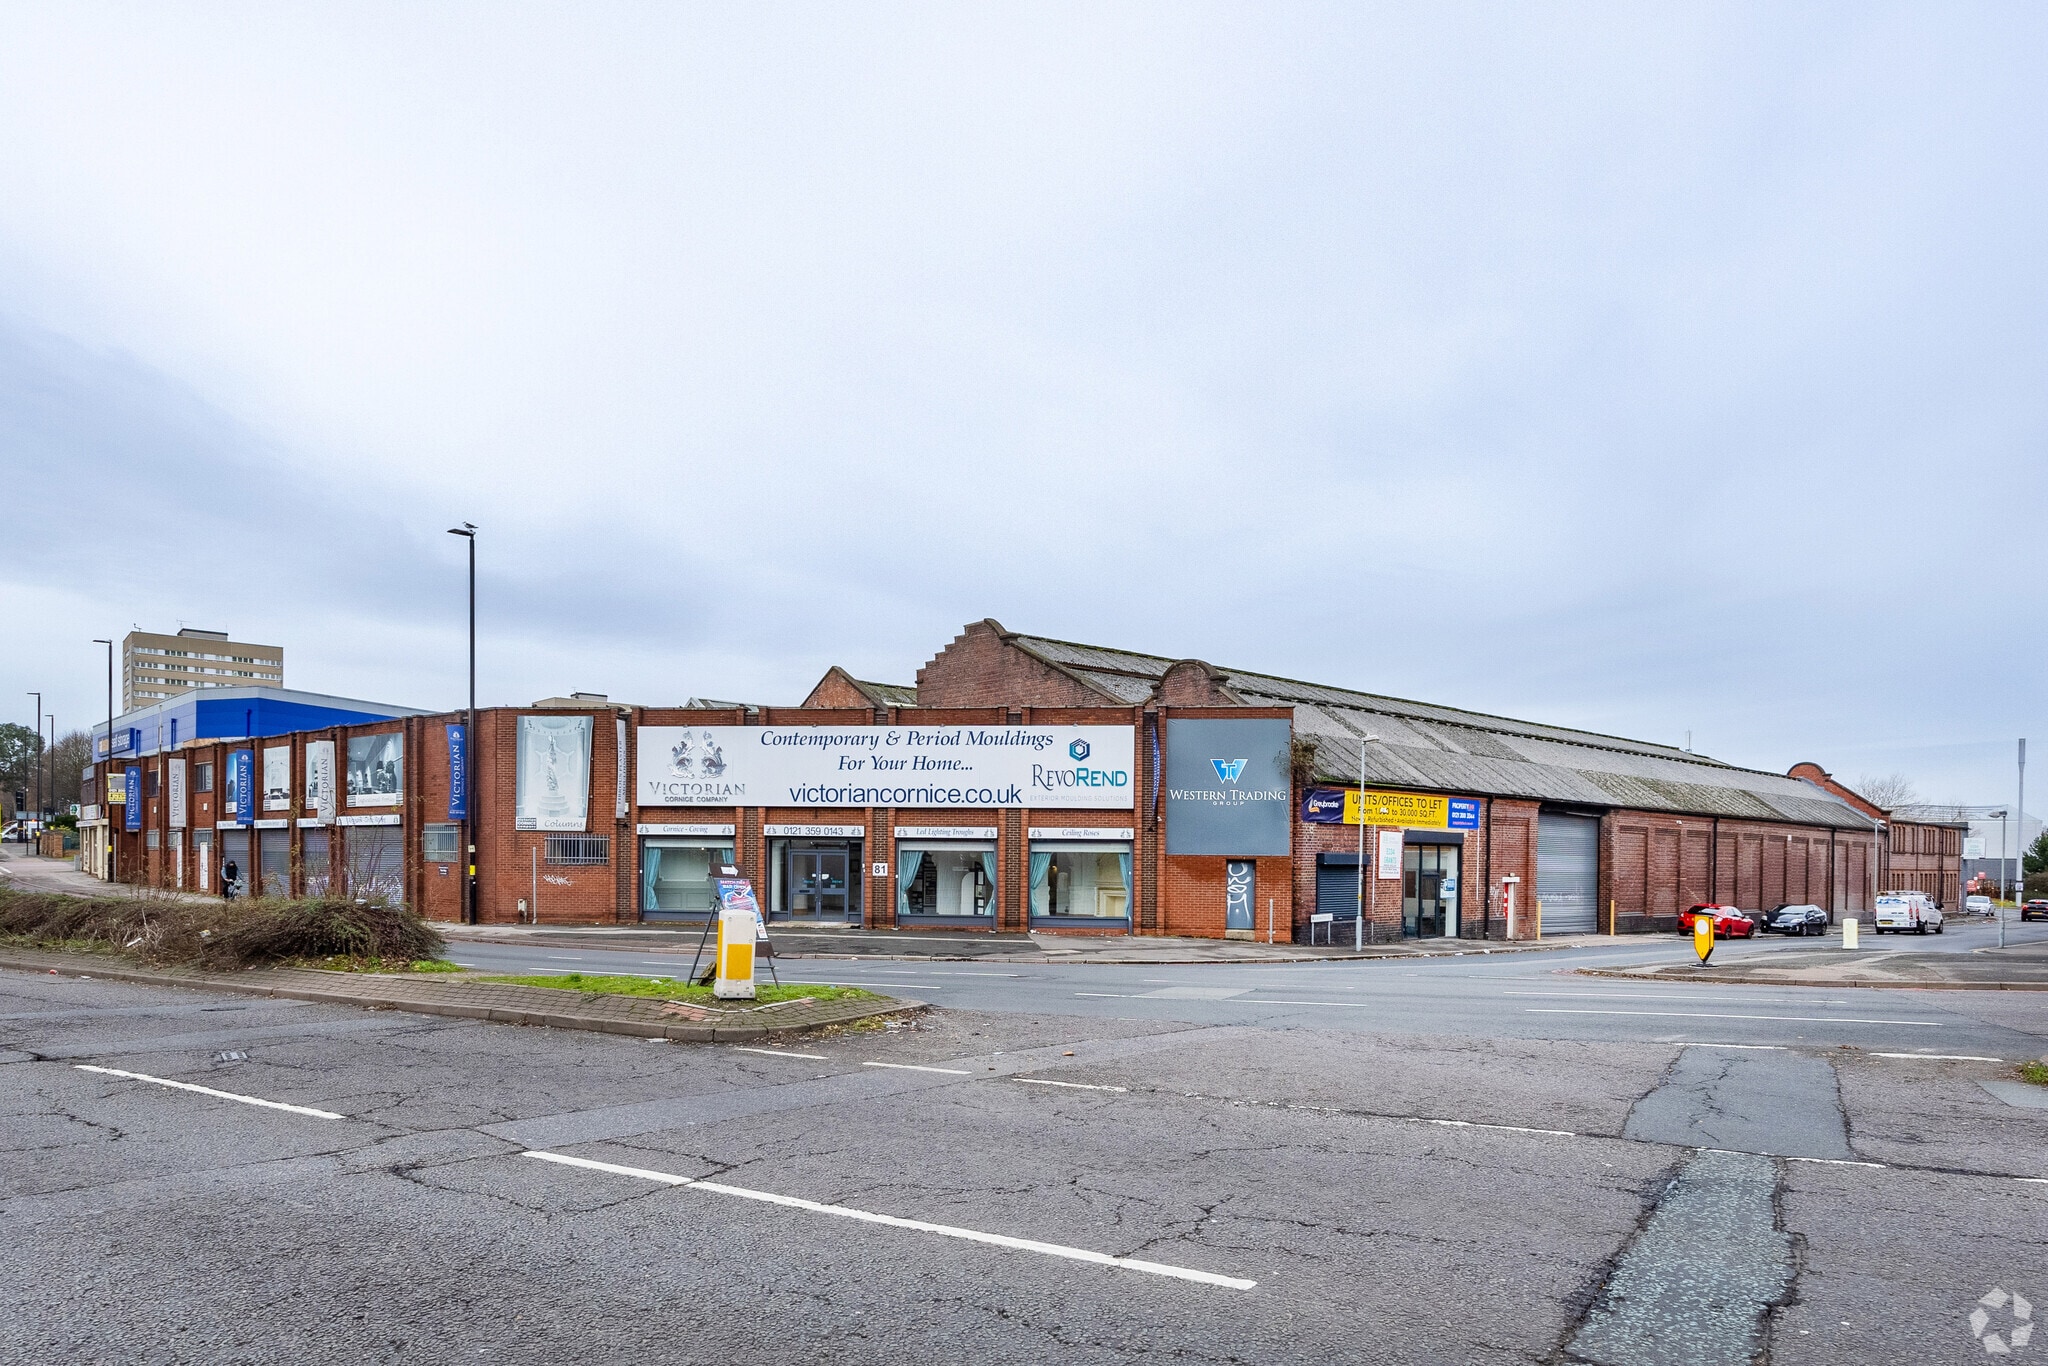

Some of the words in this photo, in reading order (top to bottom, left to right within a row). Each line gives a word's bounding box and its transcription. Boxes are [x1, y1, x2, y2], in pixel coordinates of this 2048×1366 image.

[760, 730, 880, 750] Contemporary
[885, 730, 901, 746] &
[906, 730, 962, 746] Period
[965, 730, 1054, 751] Mouldings
[838, 756, 866, 771] For
[871, 756, 908, 771] Your
[912, 756, 973, 771] Home...
[452, 745, 461, 806] VICTORIAN
[239, 765, 247, 815] VICTORIAN
[320, 758, 329, 812] VICTORIAN
[649, 781, 746, 795] VICTORIAN
[789, 783, 1023, 804] victoriancornice.co.uk
[1169, 789, 1226, 801] WESTERN
[1229, 789, 1287, 801] TRADING
[1357, 806, 1373, 814] Fom
[1417, 798, 1427, 809] TO
[1429, 799, 1443, 810] LET
[544, 819, 583, 828] Columns
[783, 826, 801, 835] 0121
[805, 826, 822, 835] 359
[823, 827, 844, 836] 0143
[874, 865, 886, 874] 81
